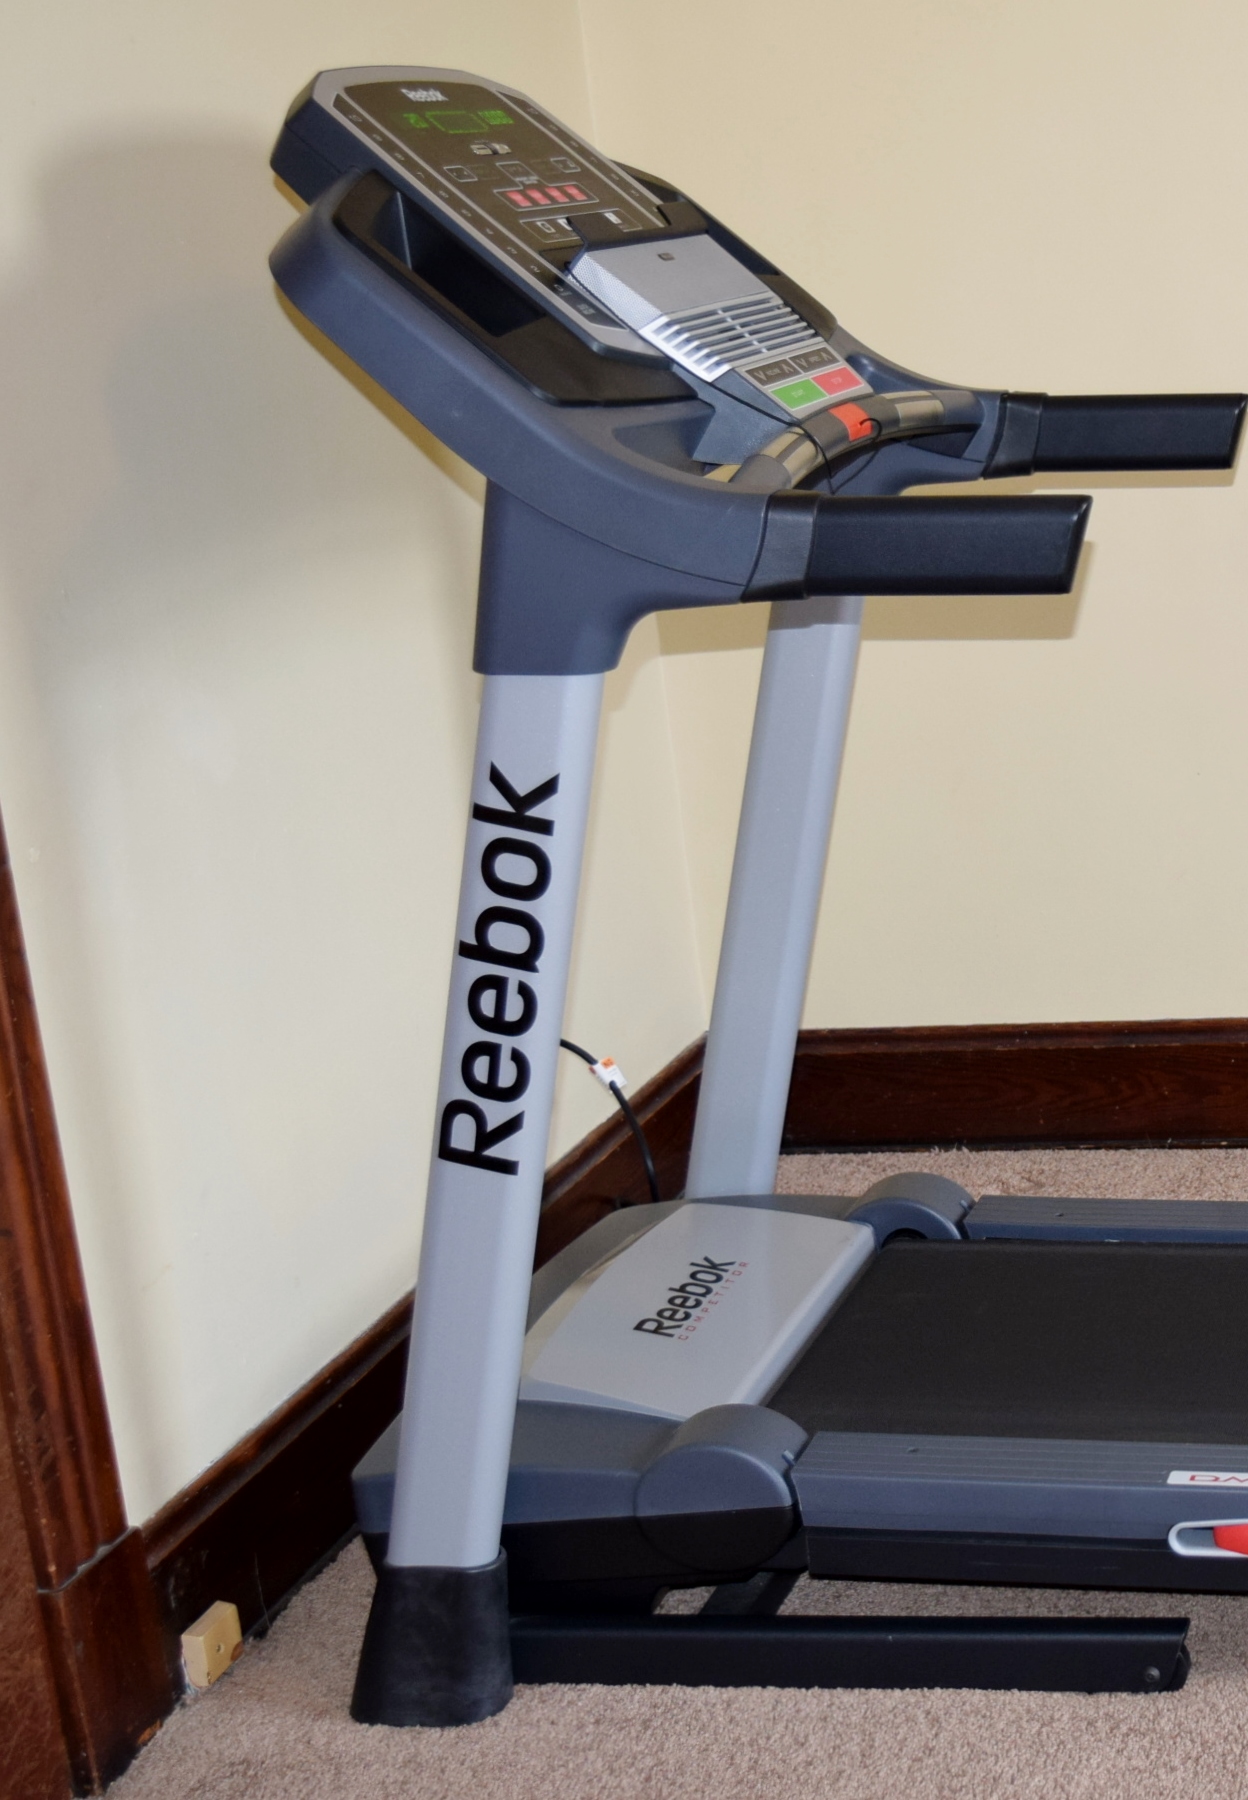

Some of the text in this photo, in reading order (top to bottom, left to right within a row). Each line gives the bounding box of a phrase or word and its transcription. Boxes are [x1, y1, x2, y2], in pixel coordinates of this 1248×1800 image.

[437, 760, 561, 1176] Reebok
[632, 1256, 737, 1338] Reebok
[677, 1261, 750, 1342] COMPETITOR
